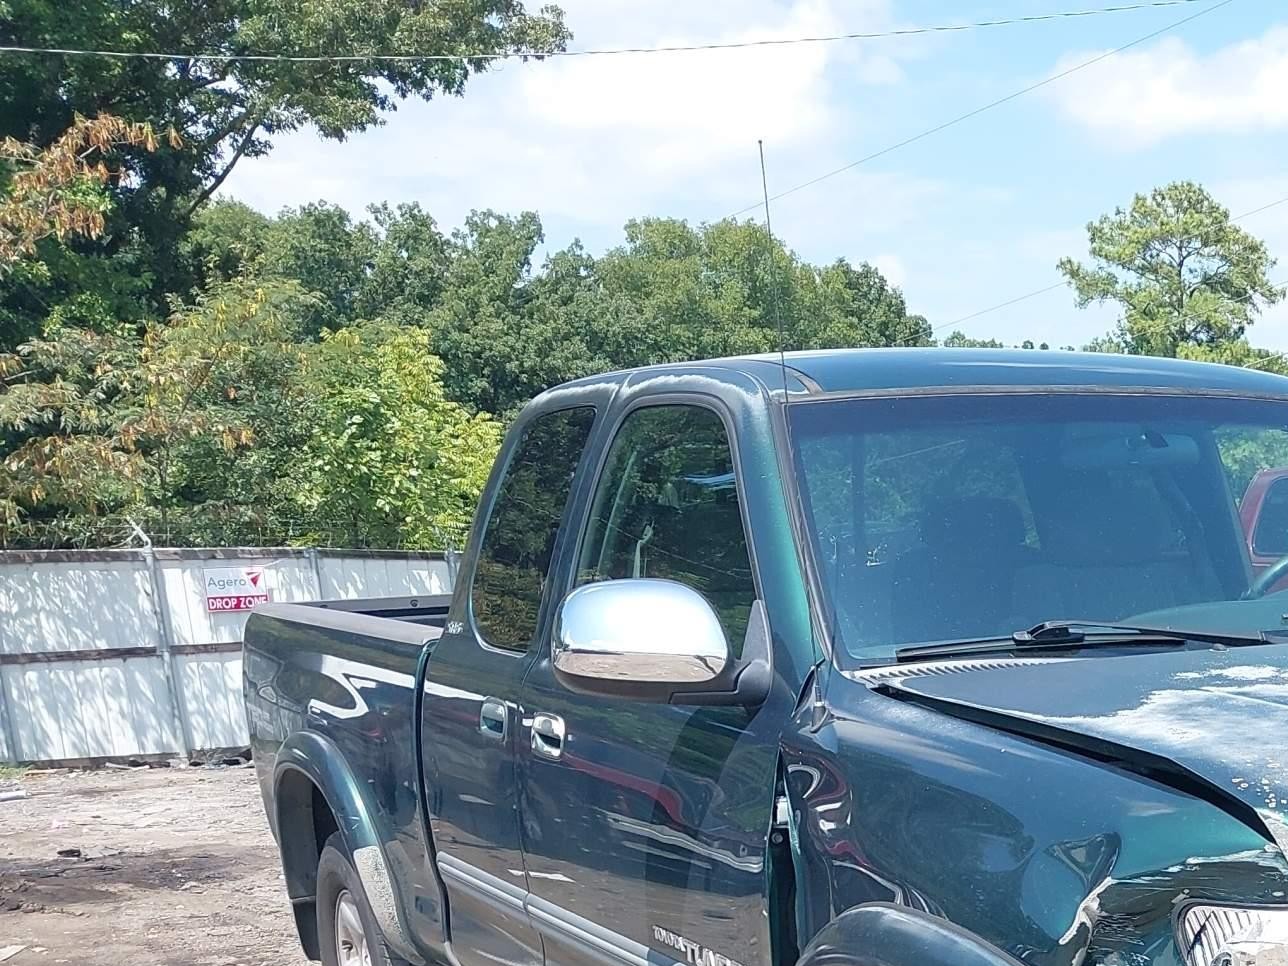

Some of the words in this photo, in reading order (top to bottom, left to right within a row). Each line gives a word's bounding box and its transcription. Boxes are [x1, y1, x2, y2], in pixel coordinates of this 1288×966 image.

[208, 576, 247, 590] Agero
[209, 597, 238, 610] DROP
[239, 596, 267, 608] ZONE
